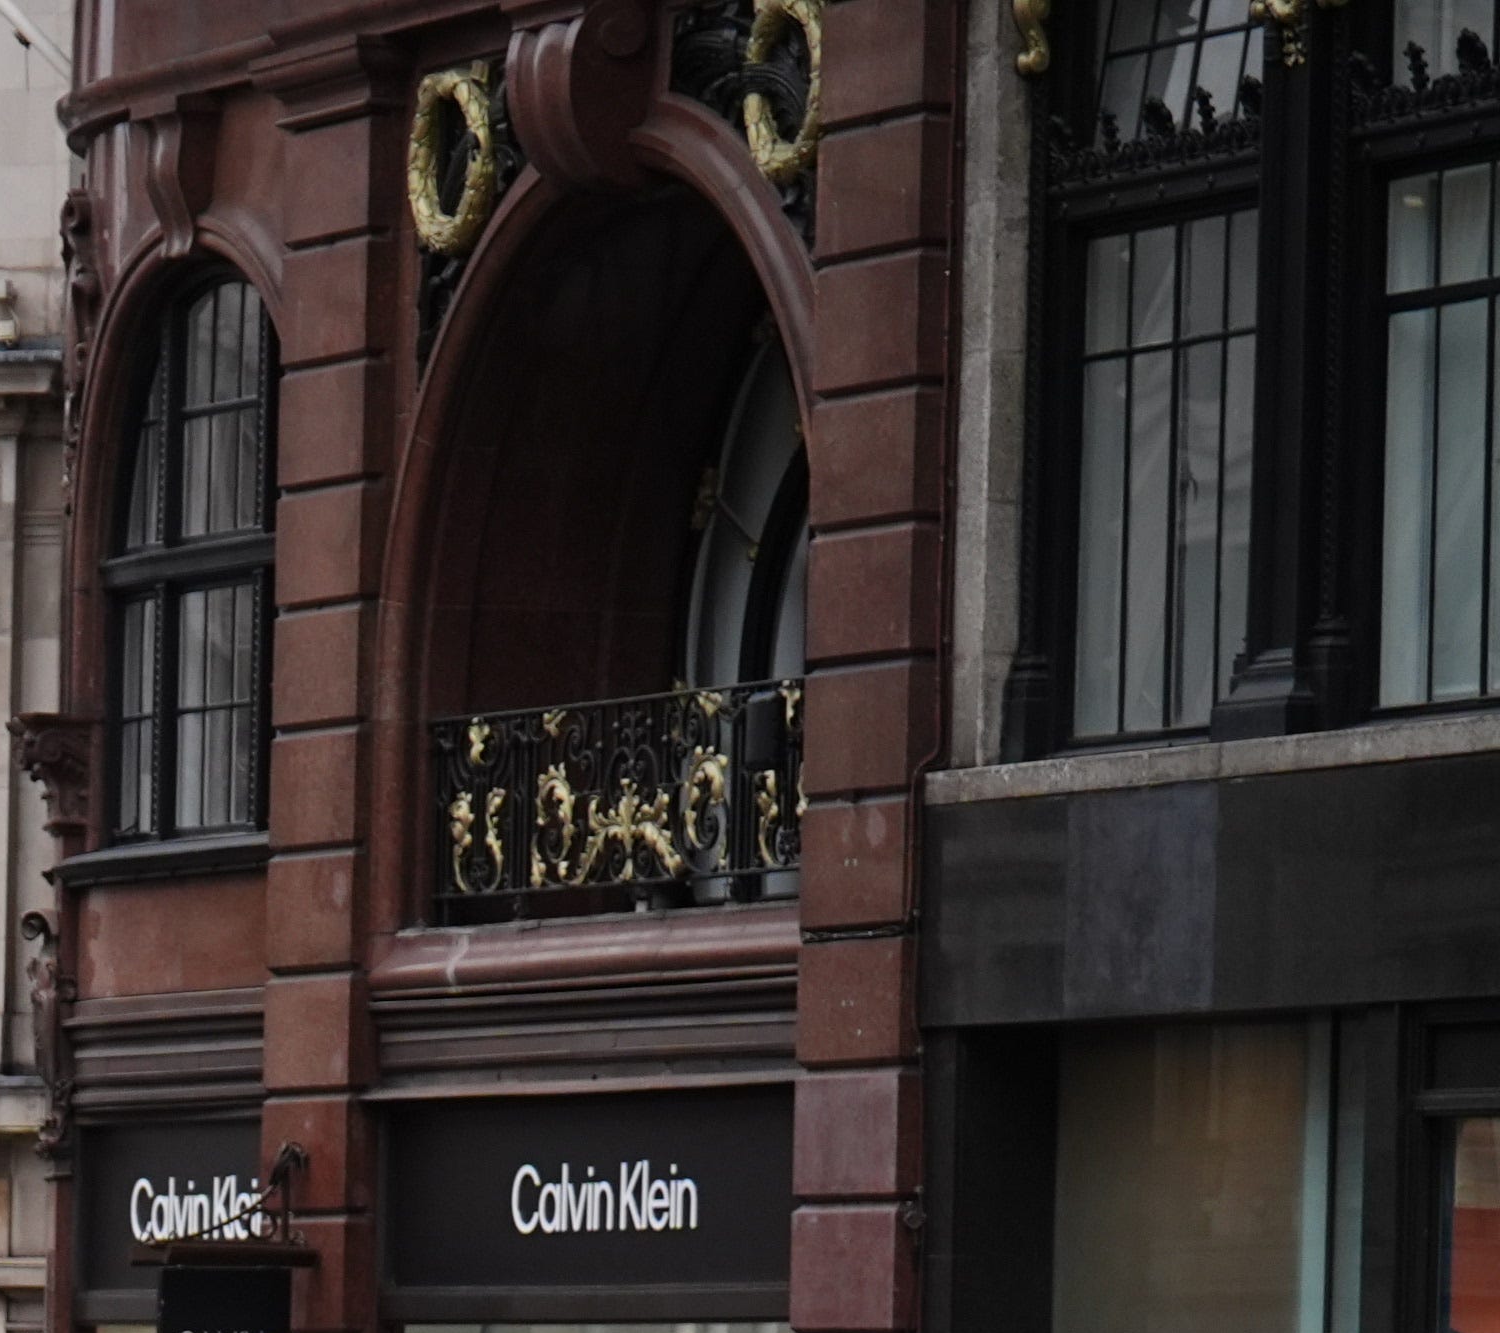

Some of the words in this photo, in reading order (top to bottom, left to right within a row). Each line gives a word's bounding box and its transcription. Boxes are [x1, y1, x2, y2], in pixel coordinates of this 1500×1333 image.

[130, 1176, 208, 1242] Calvin
[212, 1175, 262, 1241] Klei
[511, 1164, 614, 1234] Calvin
[619, 1160, 697, 1232] Klein
